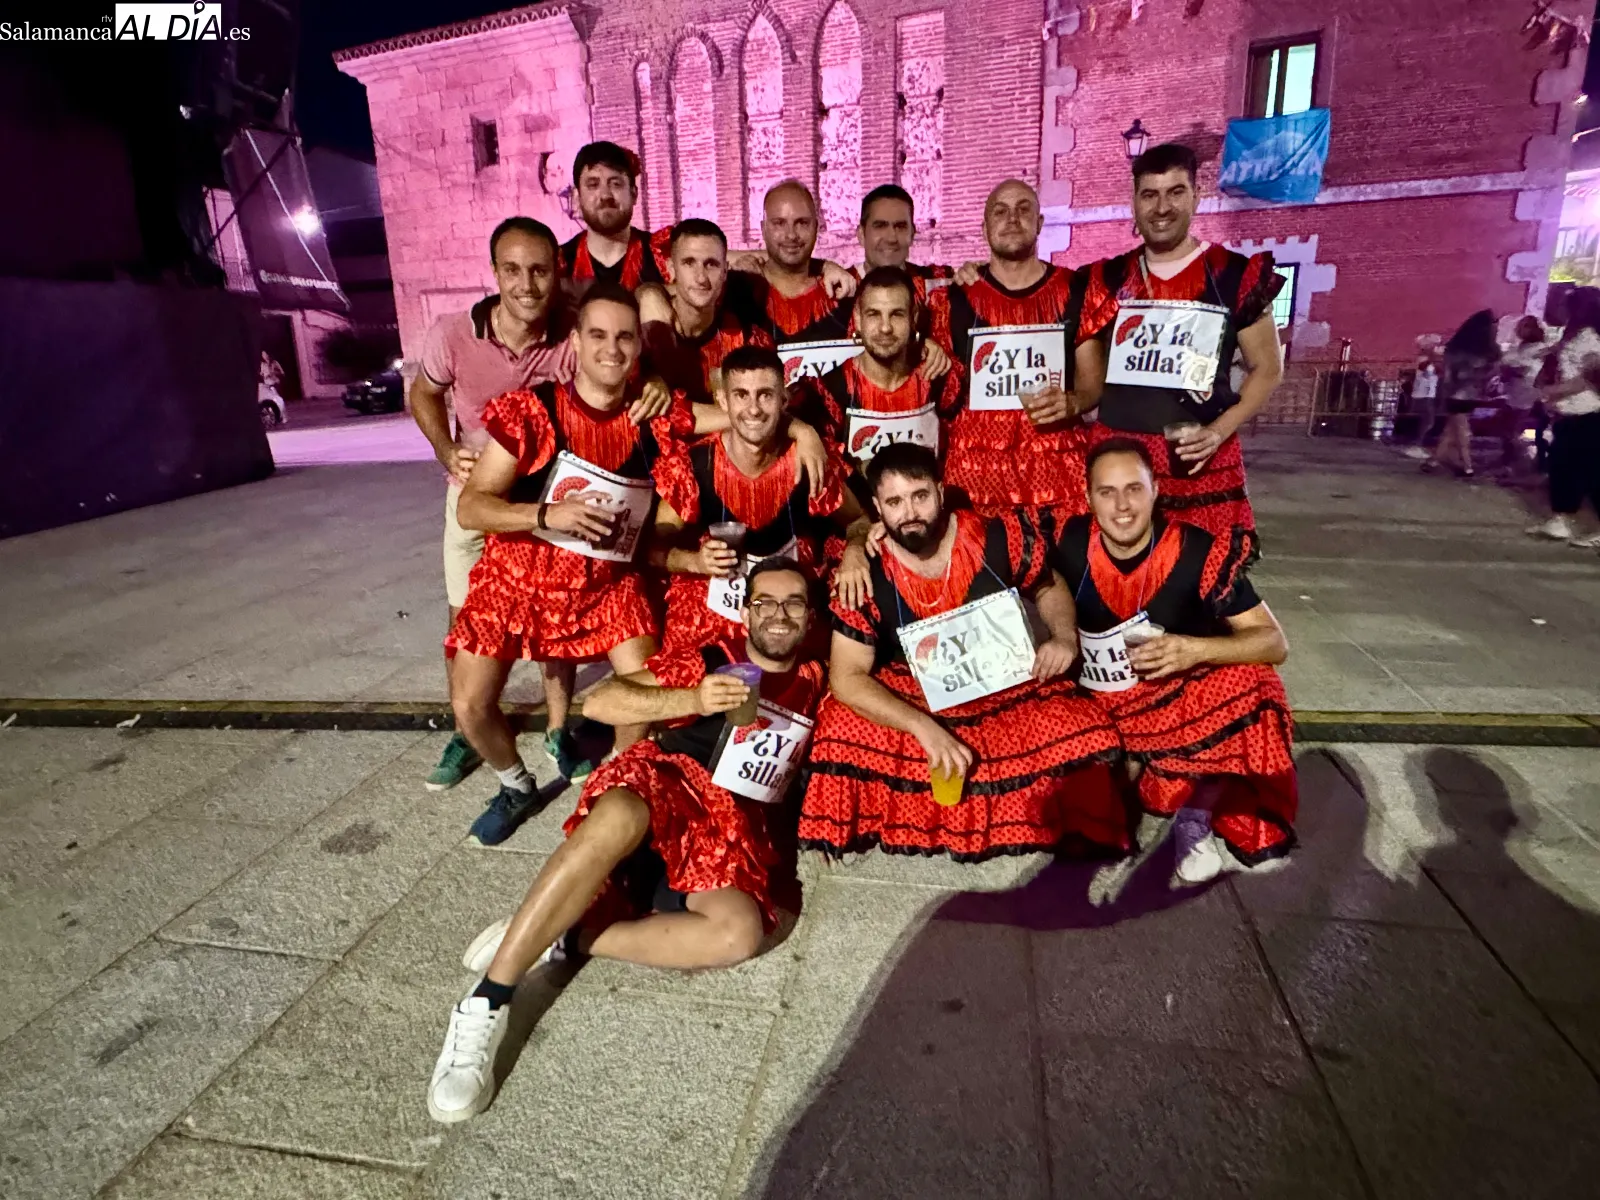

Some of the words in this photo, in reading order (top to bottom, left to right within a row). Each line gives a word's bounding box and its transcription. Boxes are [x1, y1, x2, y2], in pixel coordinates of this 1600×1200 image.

[1133, 323, 1165, 349] ¿Y
[1169, 323, 1194, 347] la
[988, 348, 1021, 375] ¿Y
[1026, 345, 1047, 369] la
[752, 732, 793, 759] ¿Y
